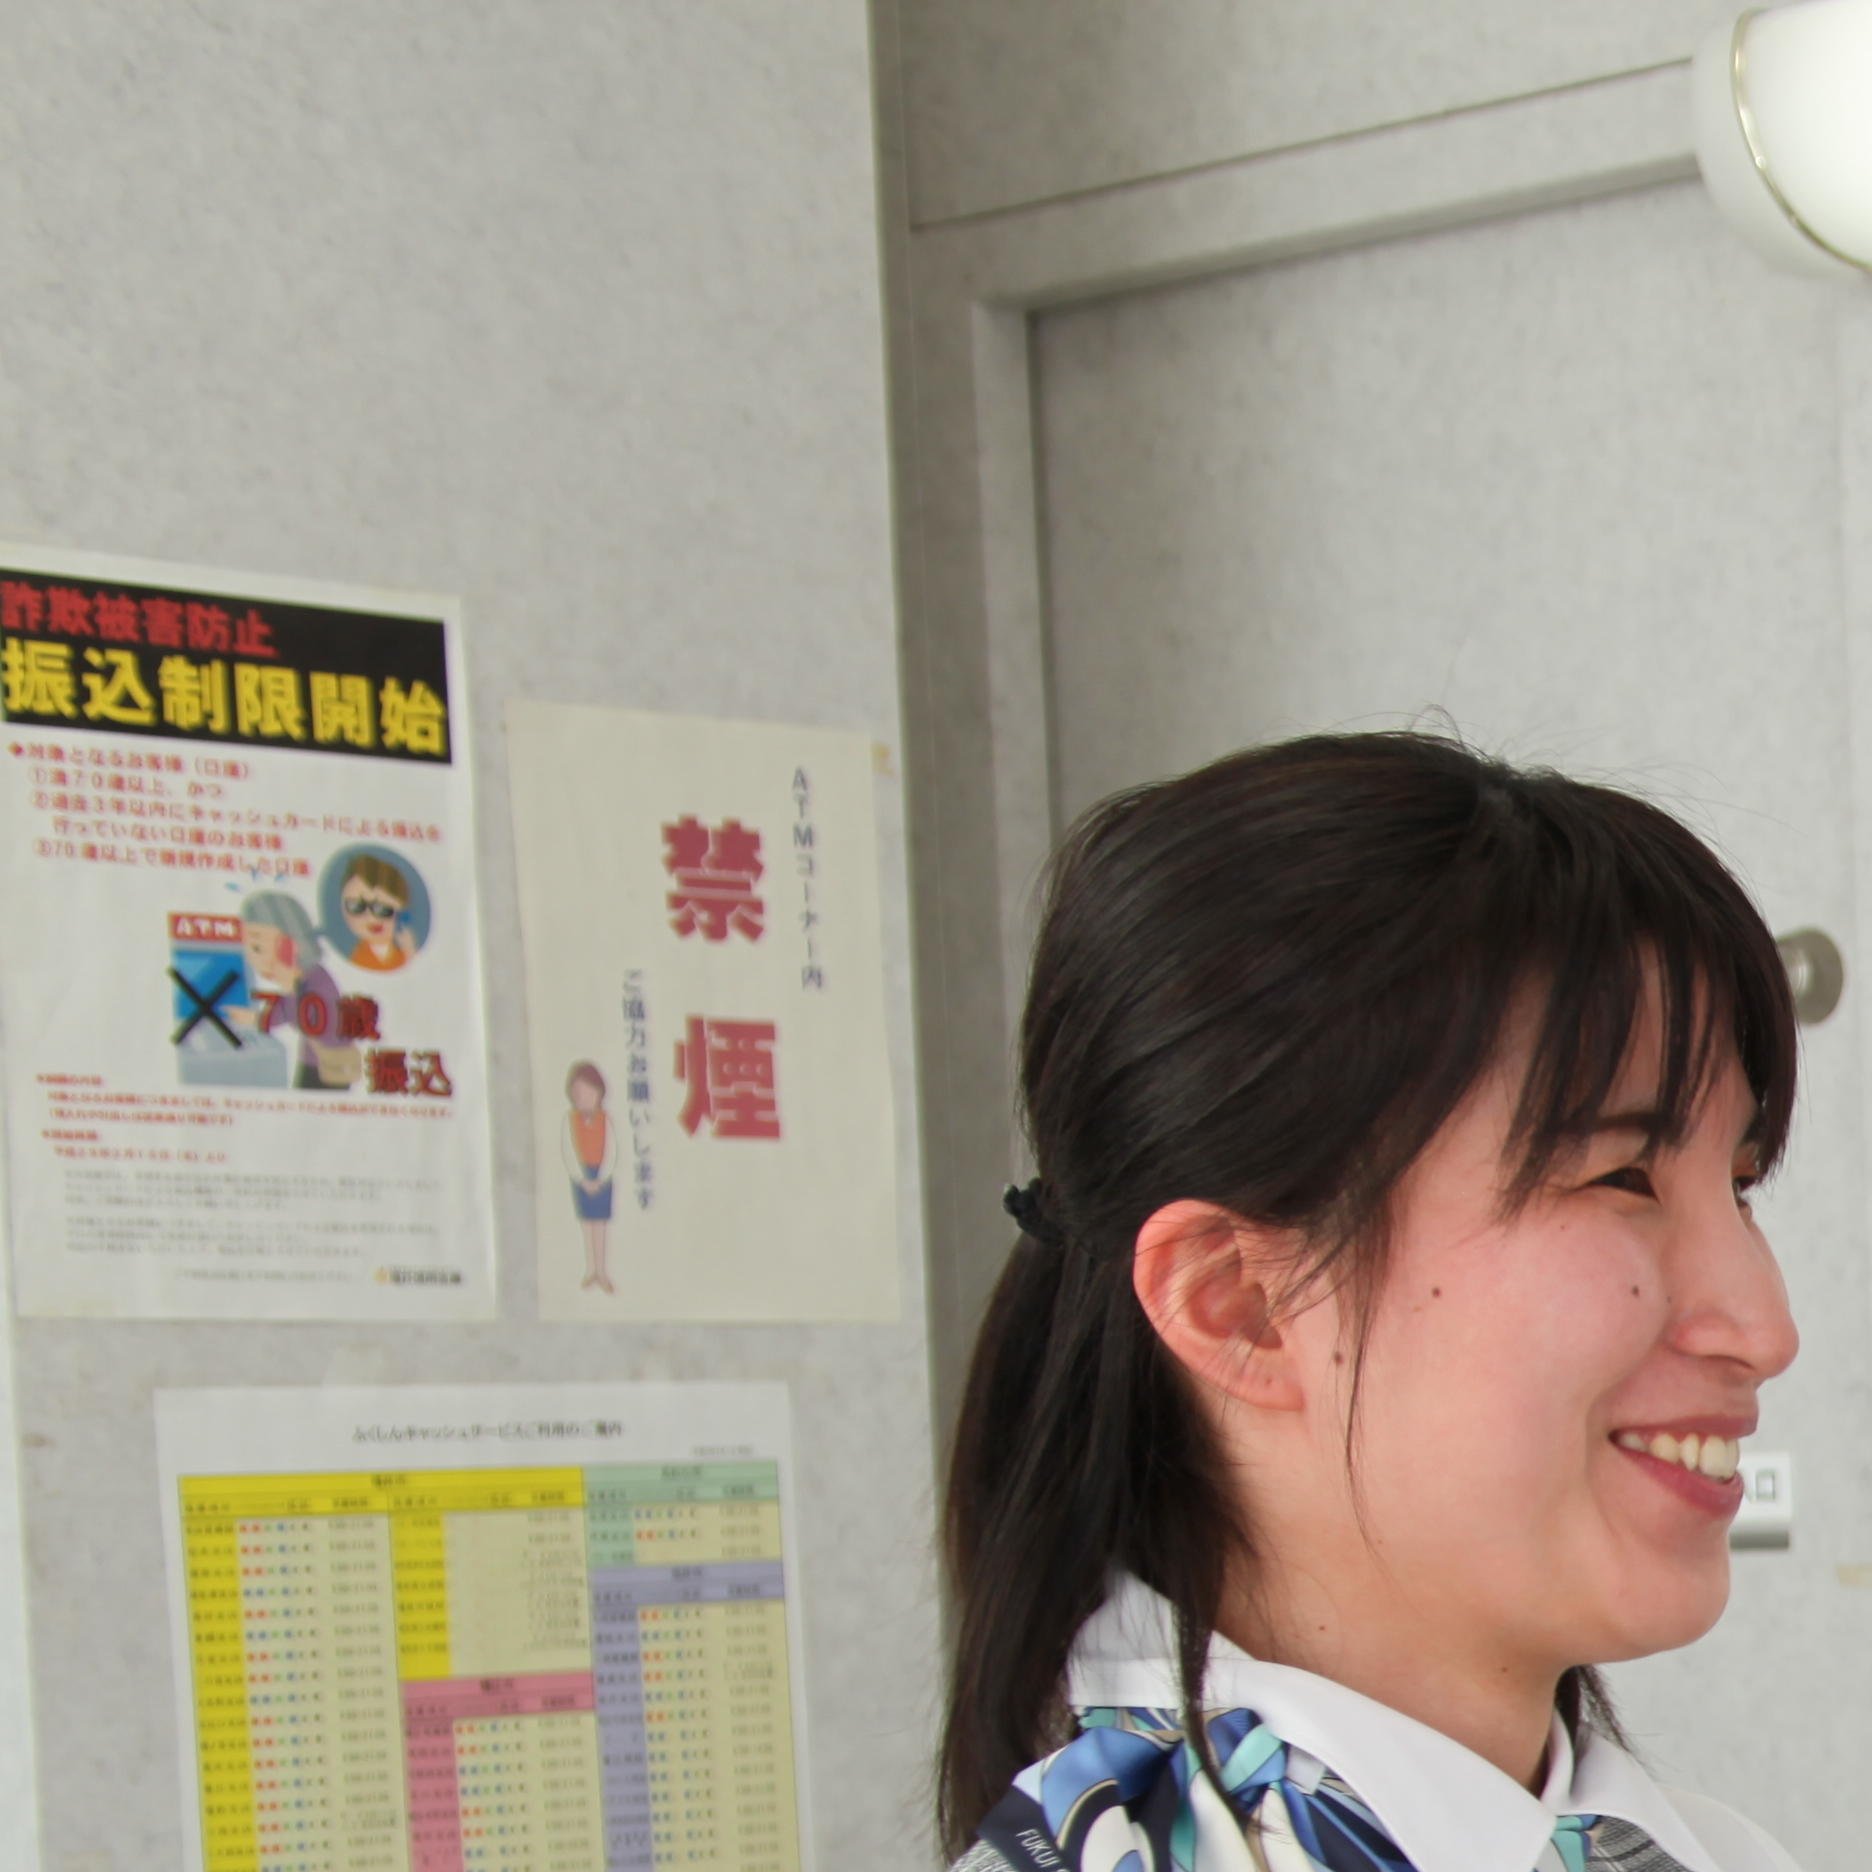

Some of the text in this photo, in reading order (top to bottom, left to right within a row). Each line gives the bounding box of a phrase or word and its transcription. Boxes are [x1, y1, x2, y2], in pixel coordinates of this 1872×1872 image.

[0, 580, 277, 658] 詐欺被害防止
[1, 636, 448, 756] 振込制限開始
[175, 917, 236, 937] ATM
[660, 813, 783, 1143] 禁煙
[1016, 1828, 1061, 1868] FUKUI
